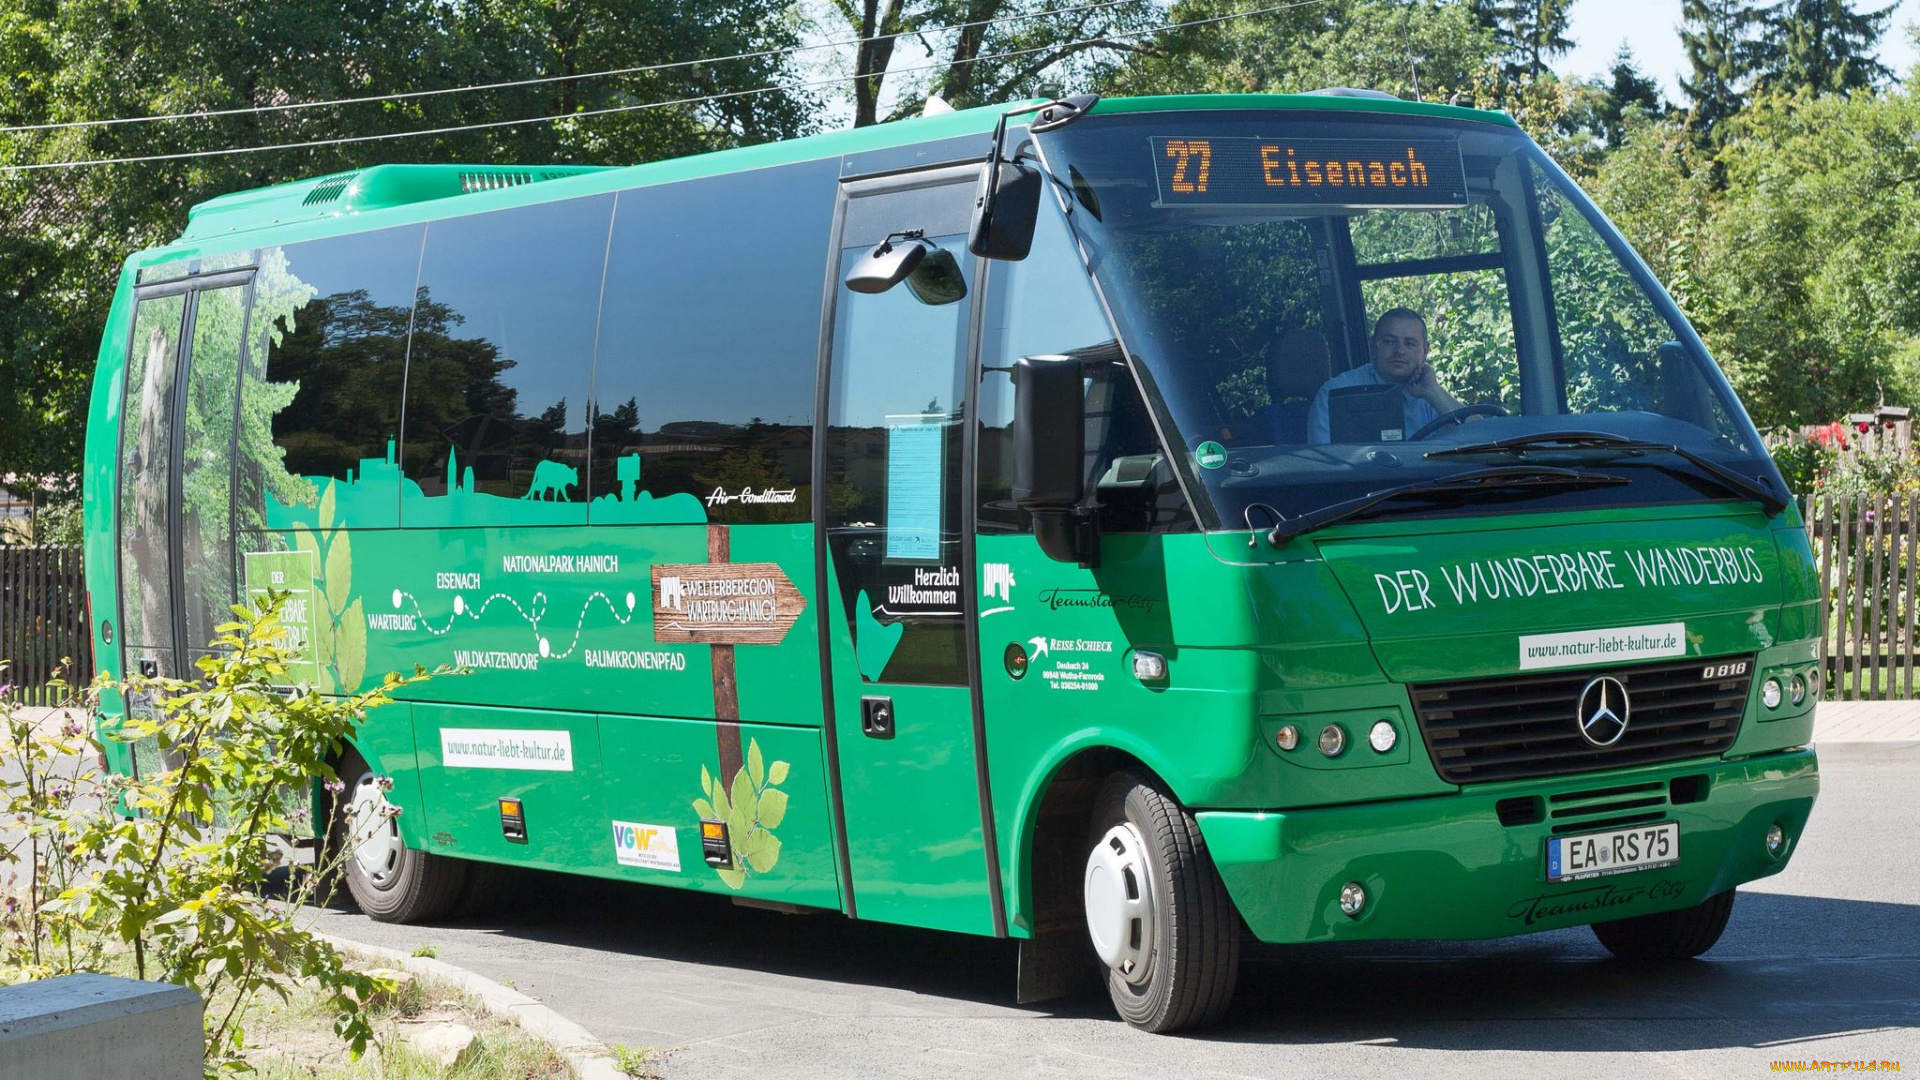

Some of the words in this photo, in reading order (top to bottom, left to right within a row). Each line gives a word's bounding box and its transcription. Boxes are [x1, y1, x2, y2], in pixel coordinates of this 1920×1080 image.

[1166, 140, 1212, 192] 27
[1261, 146, 1428, 186] Eisenach
[503, 555, 575, 573] NATIONALPARK
[576, 555, 618, 573] HAINICH
[271, 571, 285, 584] DER
[436, 572, 481, 590] EISENACH
[915, 566, 960, 586] Herzlich
[1374, 569, 1436, 615] DER
[1440, 550, 1624, 606] WUNDERBARE
[1624, 547, 1764, 588] WANDERBUS
[686, 578, 775, 596] WELTERBEREGION
[888, 586, 957, 604] Willkommen
[1038, 587, 1125, 611] Teamstar
[1127, 593, 1155, 613] City
[368, 613, 417, 631] WARTBURG
[1050, 638, 1075, 651] REISE
[1075, 639, 1113, 652] SCHIECK
[1527, 633, 1677, 660] www.natur-liebt-kultur.de
[454, 650, 539, 670] WILDKATZENDORF
[585, 649, 686, 671] BAUMKRONENPFAD
[1717, 662, 1746, 676] 818
[448, 739, 565, 761] www.natur-liebt-kultur.de
[614, 825, 658, 851] VGW
[1570, 839, 1598, 870] EA
[1612, 833, 1639, 863] RS
[1645, 829, 1669, 859] 75
[1507, 884, 1644, 925] Teamstar
[1645, 879, 1695, 900] City
